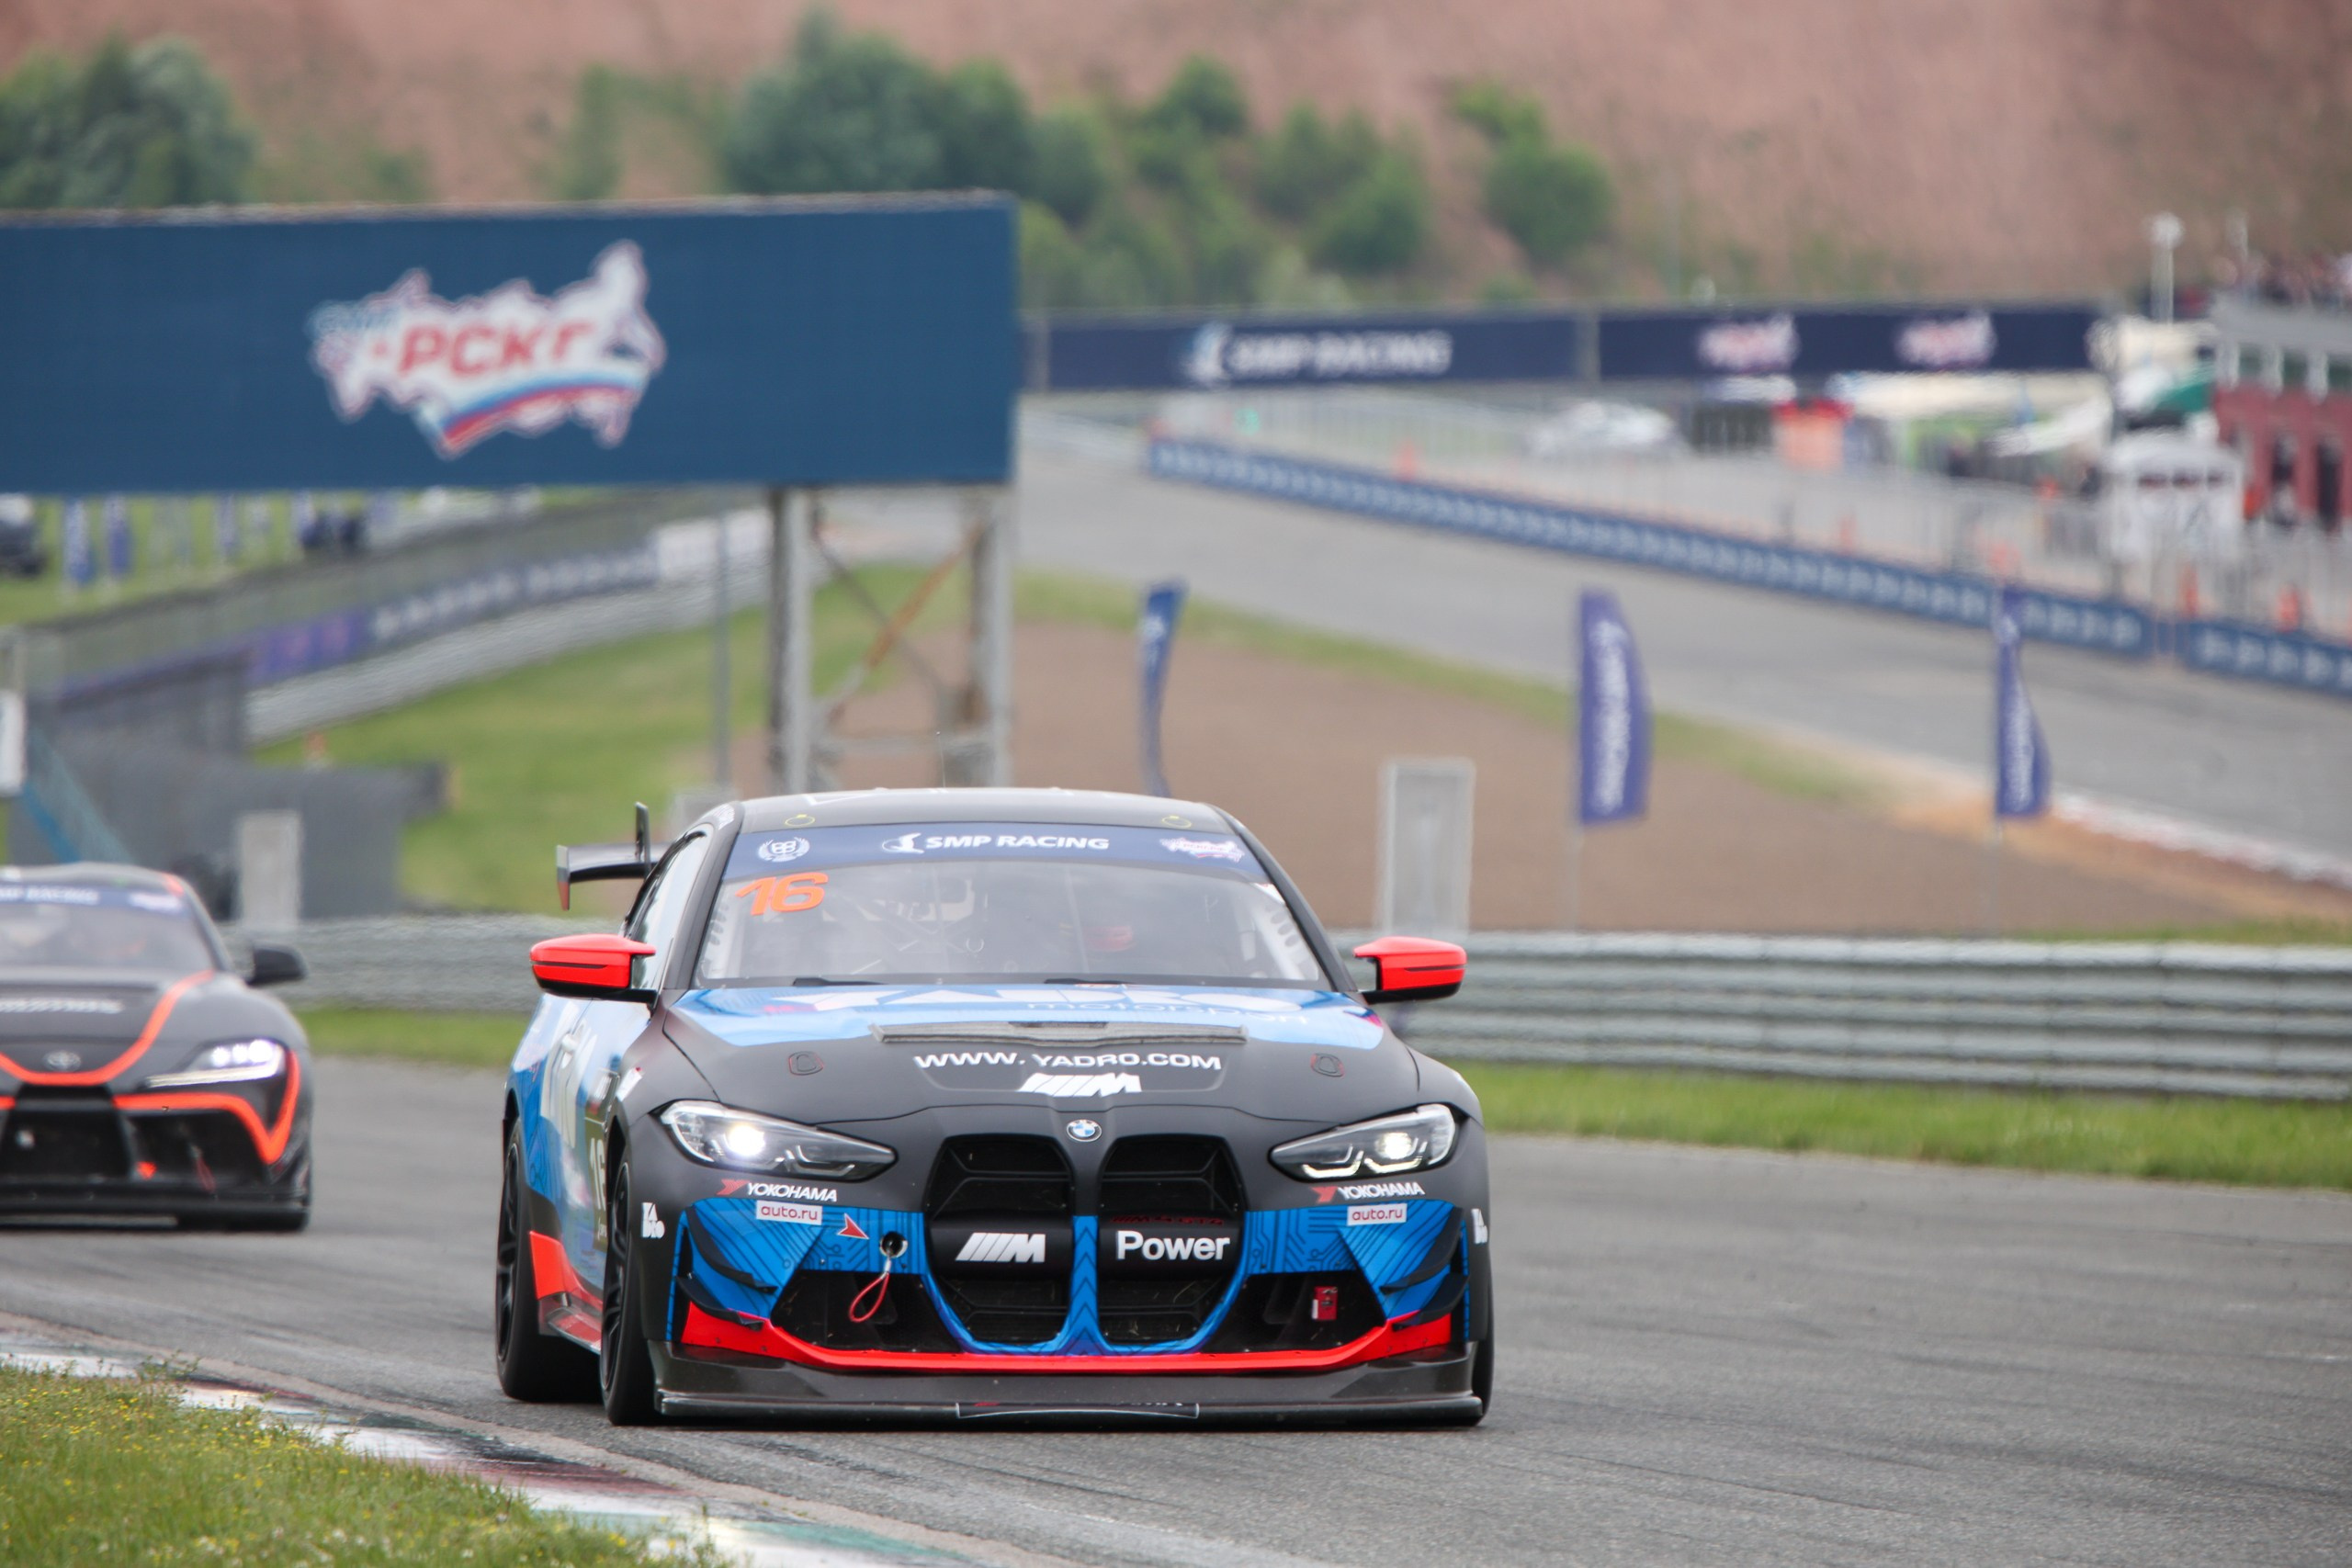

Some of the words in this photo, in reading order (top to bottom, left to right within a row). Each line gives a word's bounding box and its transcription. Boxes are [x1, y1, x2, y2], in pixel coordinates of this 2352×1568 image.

[926, 835, 992, 849] SMP
[997, 835, 1110, 850] RACING
[736, 872, 829, 916] 16
[747, 1182, 838, 1202] YOKOHAMA
[1338, 1181, 1425, 1200] YOKOHAMA
[761, 1205, 818, 1221] auto.ru
[1352, 1208, 1403, 1221] auto.ru
[1116, 1230, 1231, 1260] Power
